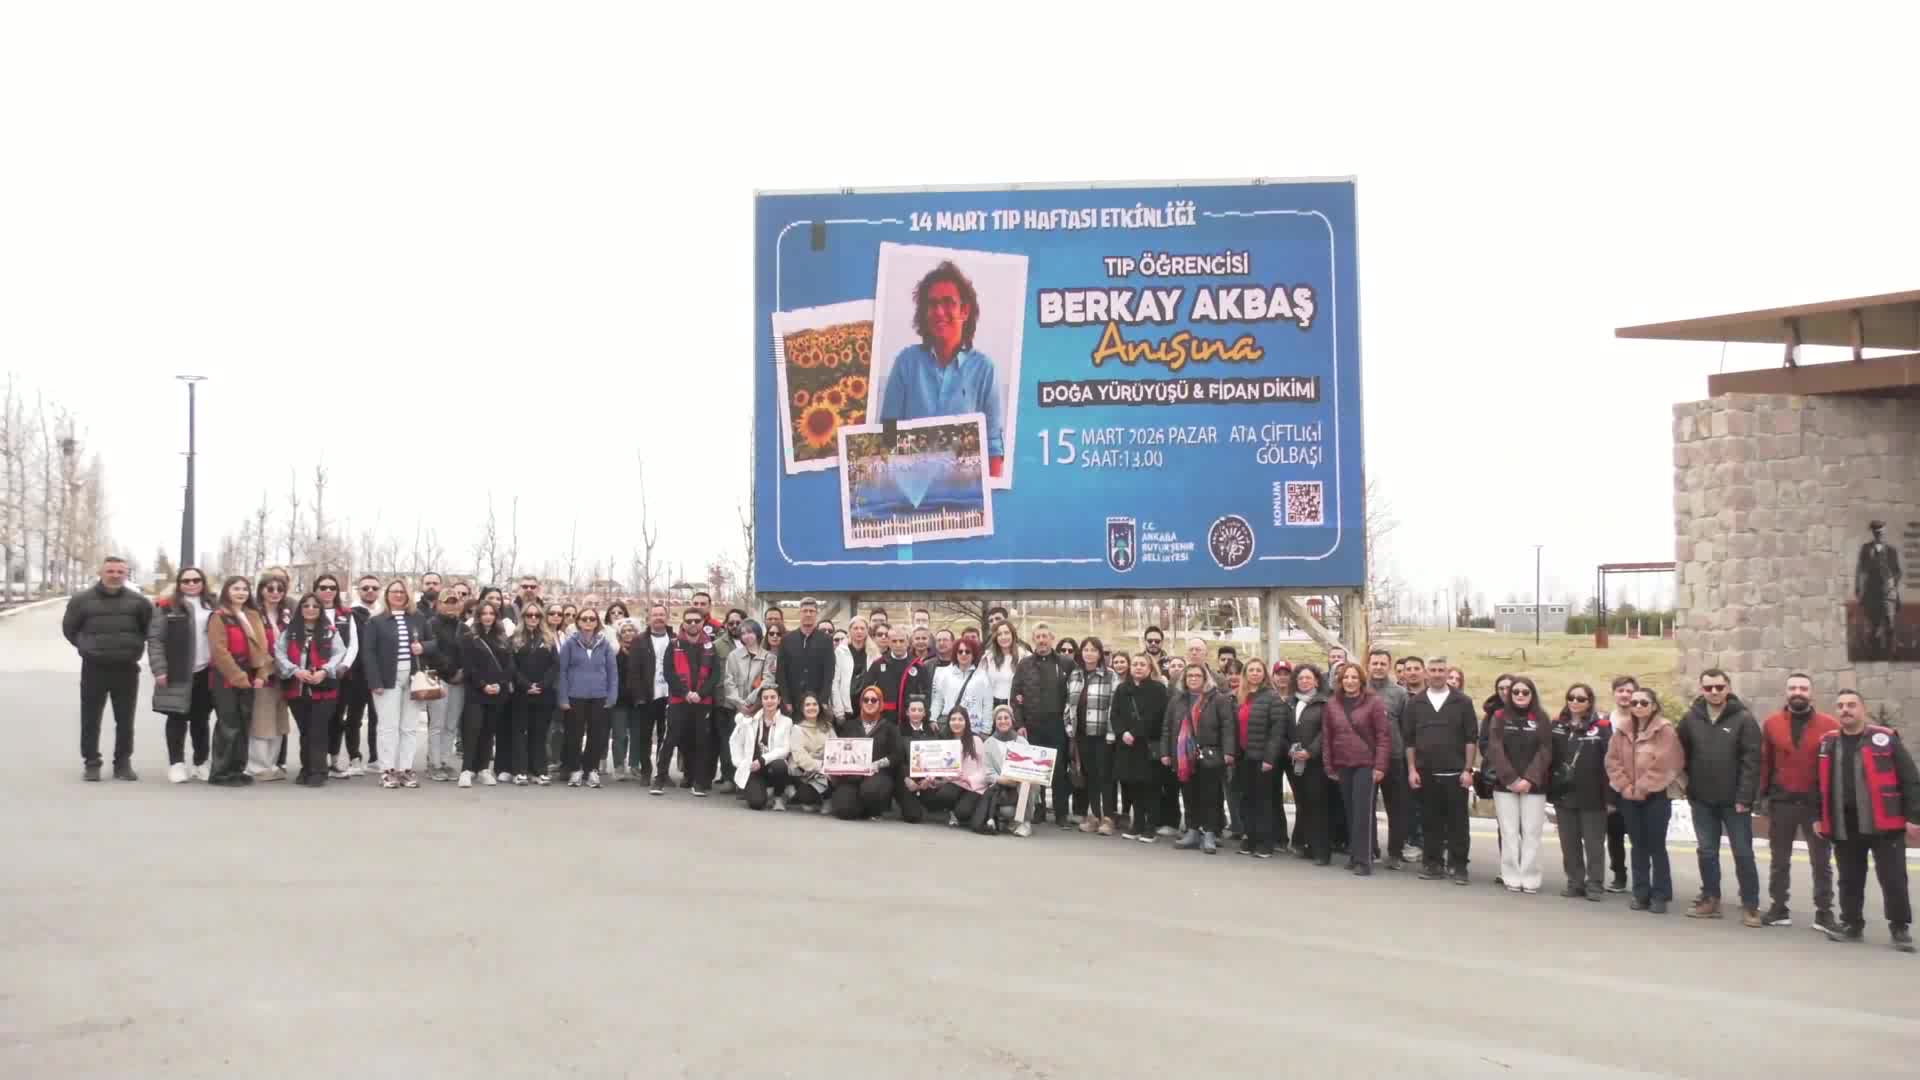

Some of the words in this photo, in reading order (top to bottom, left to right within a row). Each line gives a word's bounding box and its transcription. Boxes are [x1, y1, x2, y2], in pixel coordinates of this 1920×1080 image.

[910, 211, 932, 231] 14
[936, 209, 987, 231] MART
[992, 208, 1020, 230] TIP
[1024, 208, 1097, 230] HAFTASI
[1104, 258, 1135, 276] TIP
[1140, 250, 1249, 275] ÖĞRENCİSİ
[1040, 290, 1182, 323] BERKAY
[1192, 287, 1314, 327] AKBAŞ
[1043, 384, 1093, 403] DOĞA
[1098, 381, 1188, 403] YÜRÜYÜŞÜ
[1193, 384, 1204, 399] &
[1263, 377, 1315, 399] DİKİMİ
[1038, 428, 1076, 466] 15
[1081, 428, 1124, 445] MART
[1169, 426, 1217, 444] PAZAR
[1229, 425, 1257, 443] ATA
[1256, 444, 1322, 470] GÖLBAŞI
[1272, 481, 1282, 526] KONUM
